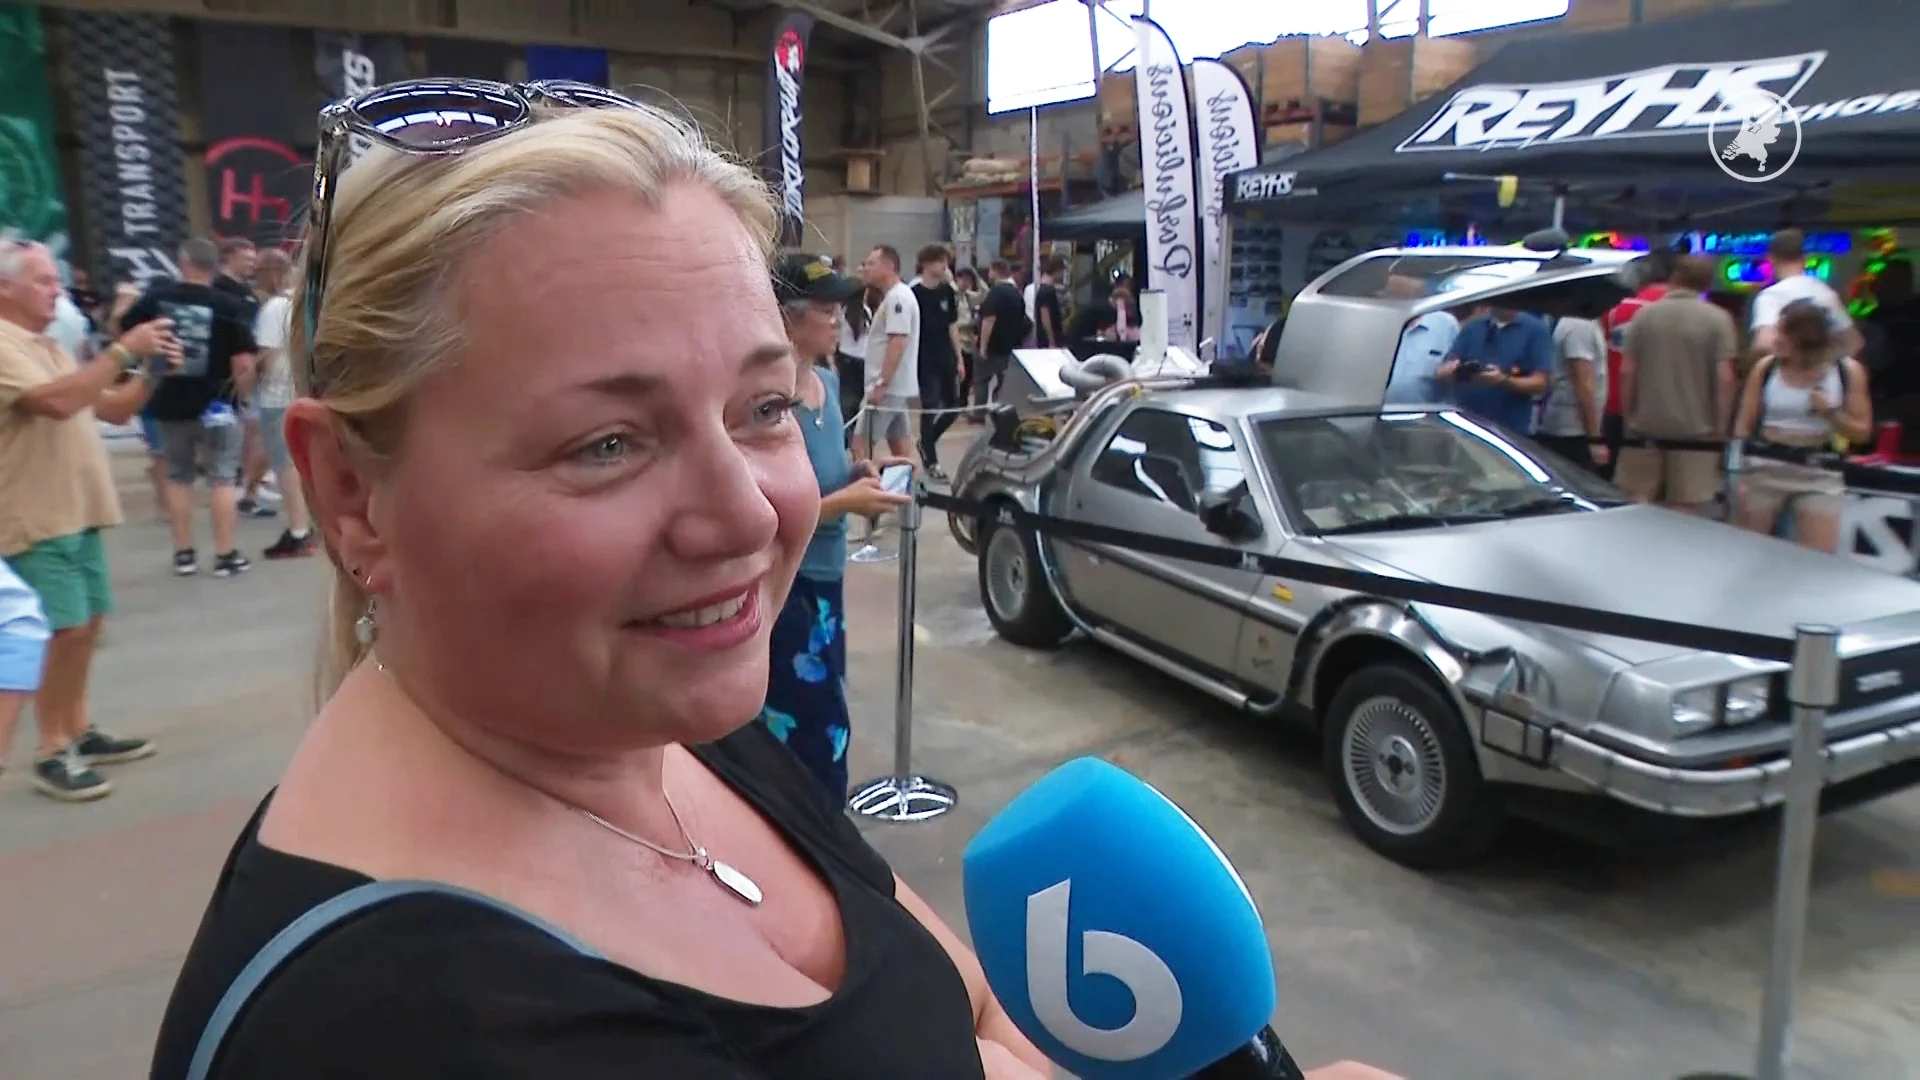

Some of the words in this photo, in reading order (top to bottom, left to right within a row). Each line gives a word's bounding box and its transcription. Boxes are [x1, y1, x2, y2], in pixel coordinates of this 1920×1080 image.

[1414, 61, 1801, 149] REYHS
[104, 68, 158, 237] TRANSPORT
[1236, 172, 1297, 199] REYHS
